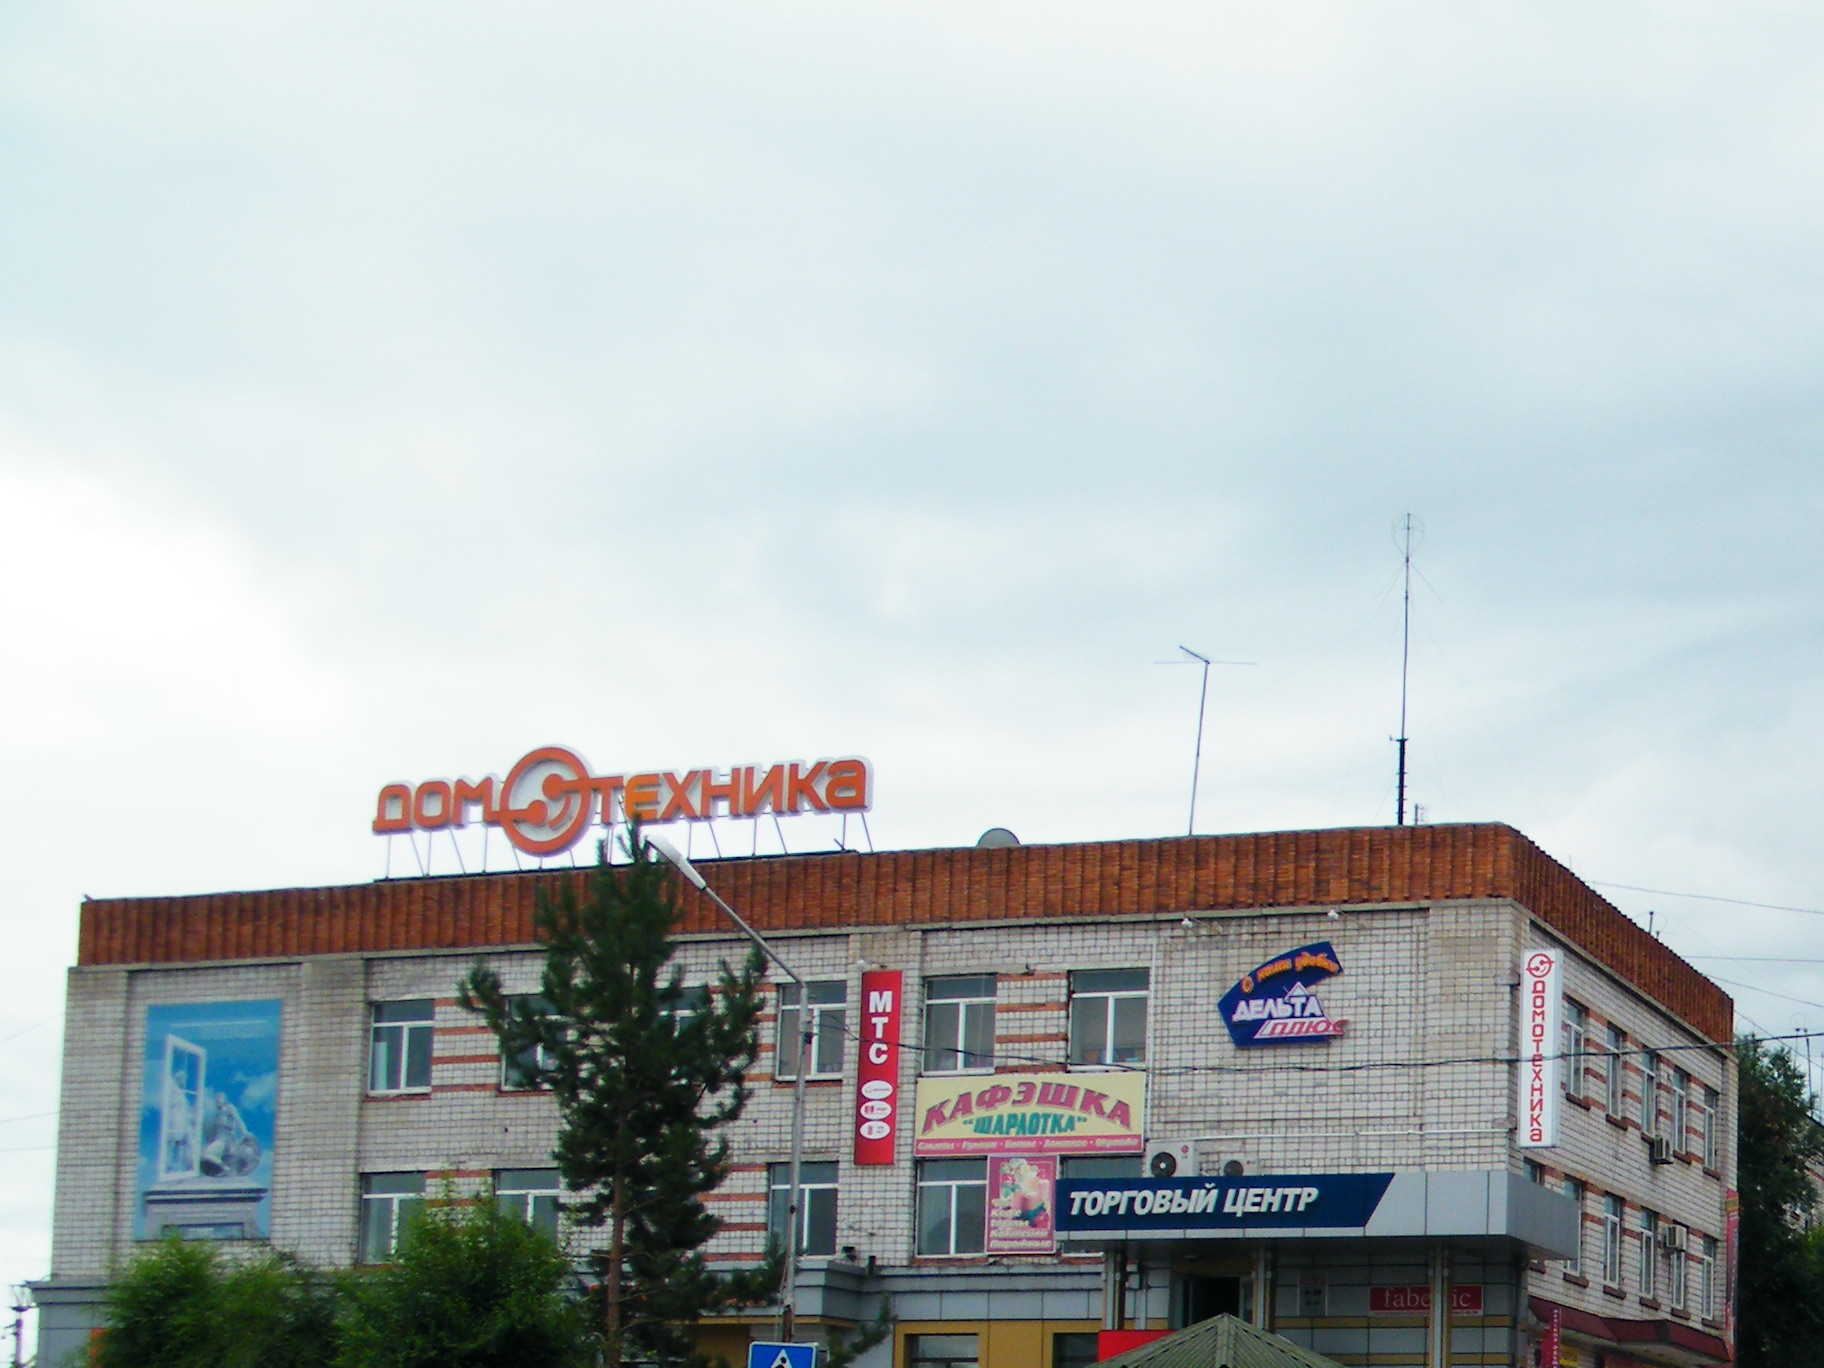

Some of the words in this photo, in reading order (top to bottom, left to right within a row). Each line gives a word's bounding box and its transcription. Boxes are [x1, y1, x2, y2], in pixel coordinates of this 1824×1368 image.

[1232, 995, 1323, 1022] ДЕЛЬТА
[868, 990, 893, 1065] МТС
[1267, 1019, 1350, 1036] ПЛЮС
[921, 1081, 1133, 1136] КАФЭШКА
[1069, 1182, 1220, 1217] ТОРГОВЫЙ
[1222, 1186, 1320, 1218] ЦЕНТР
[1383, 1286, 1472, 1309] fabeic
